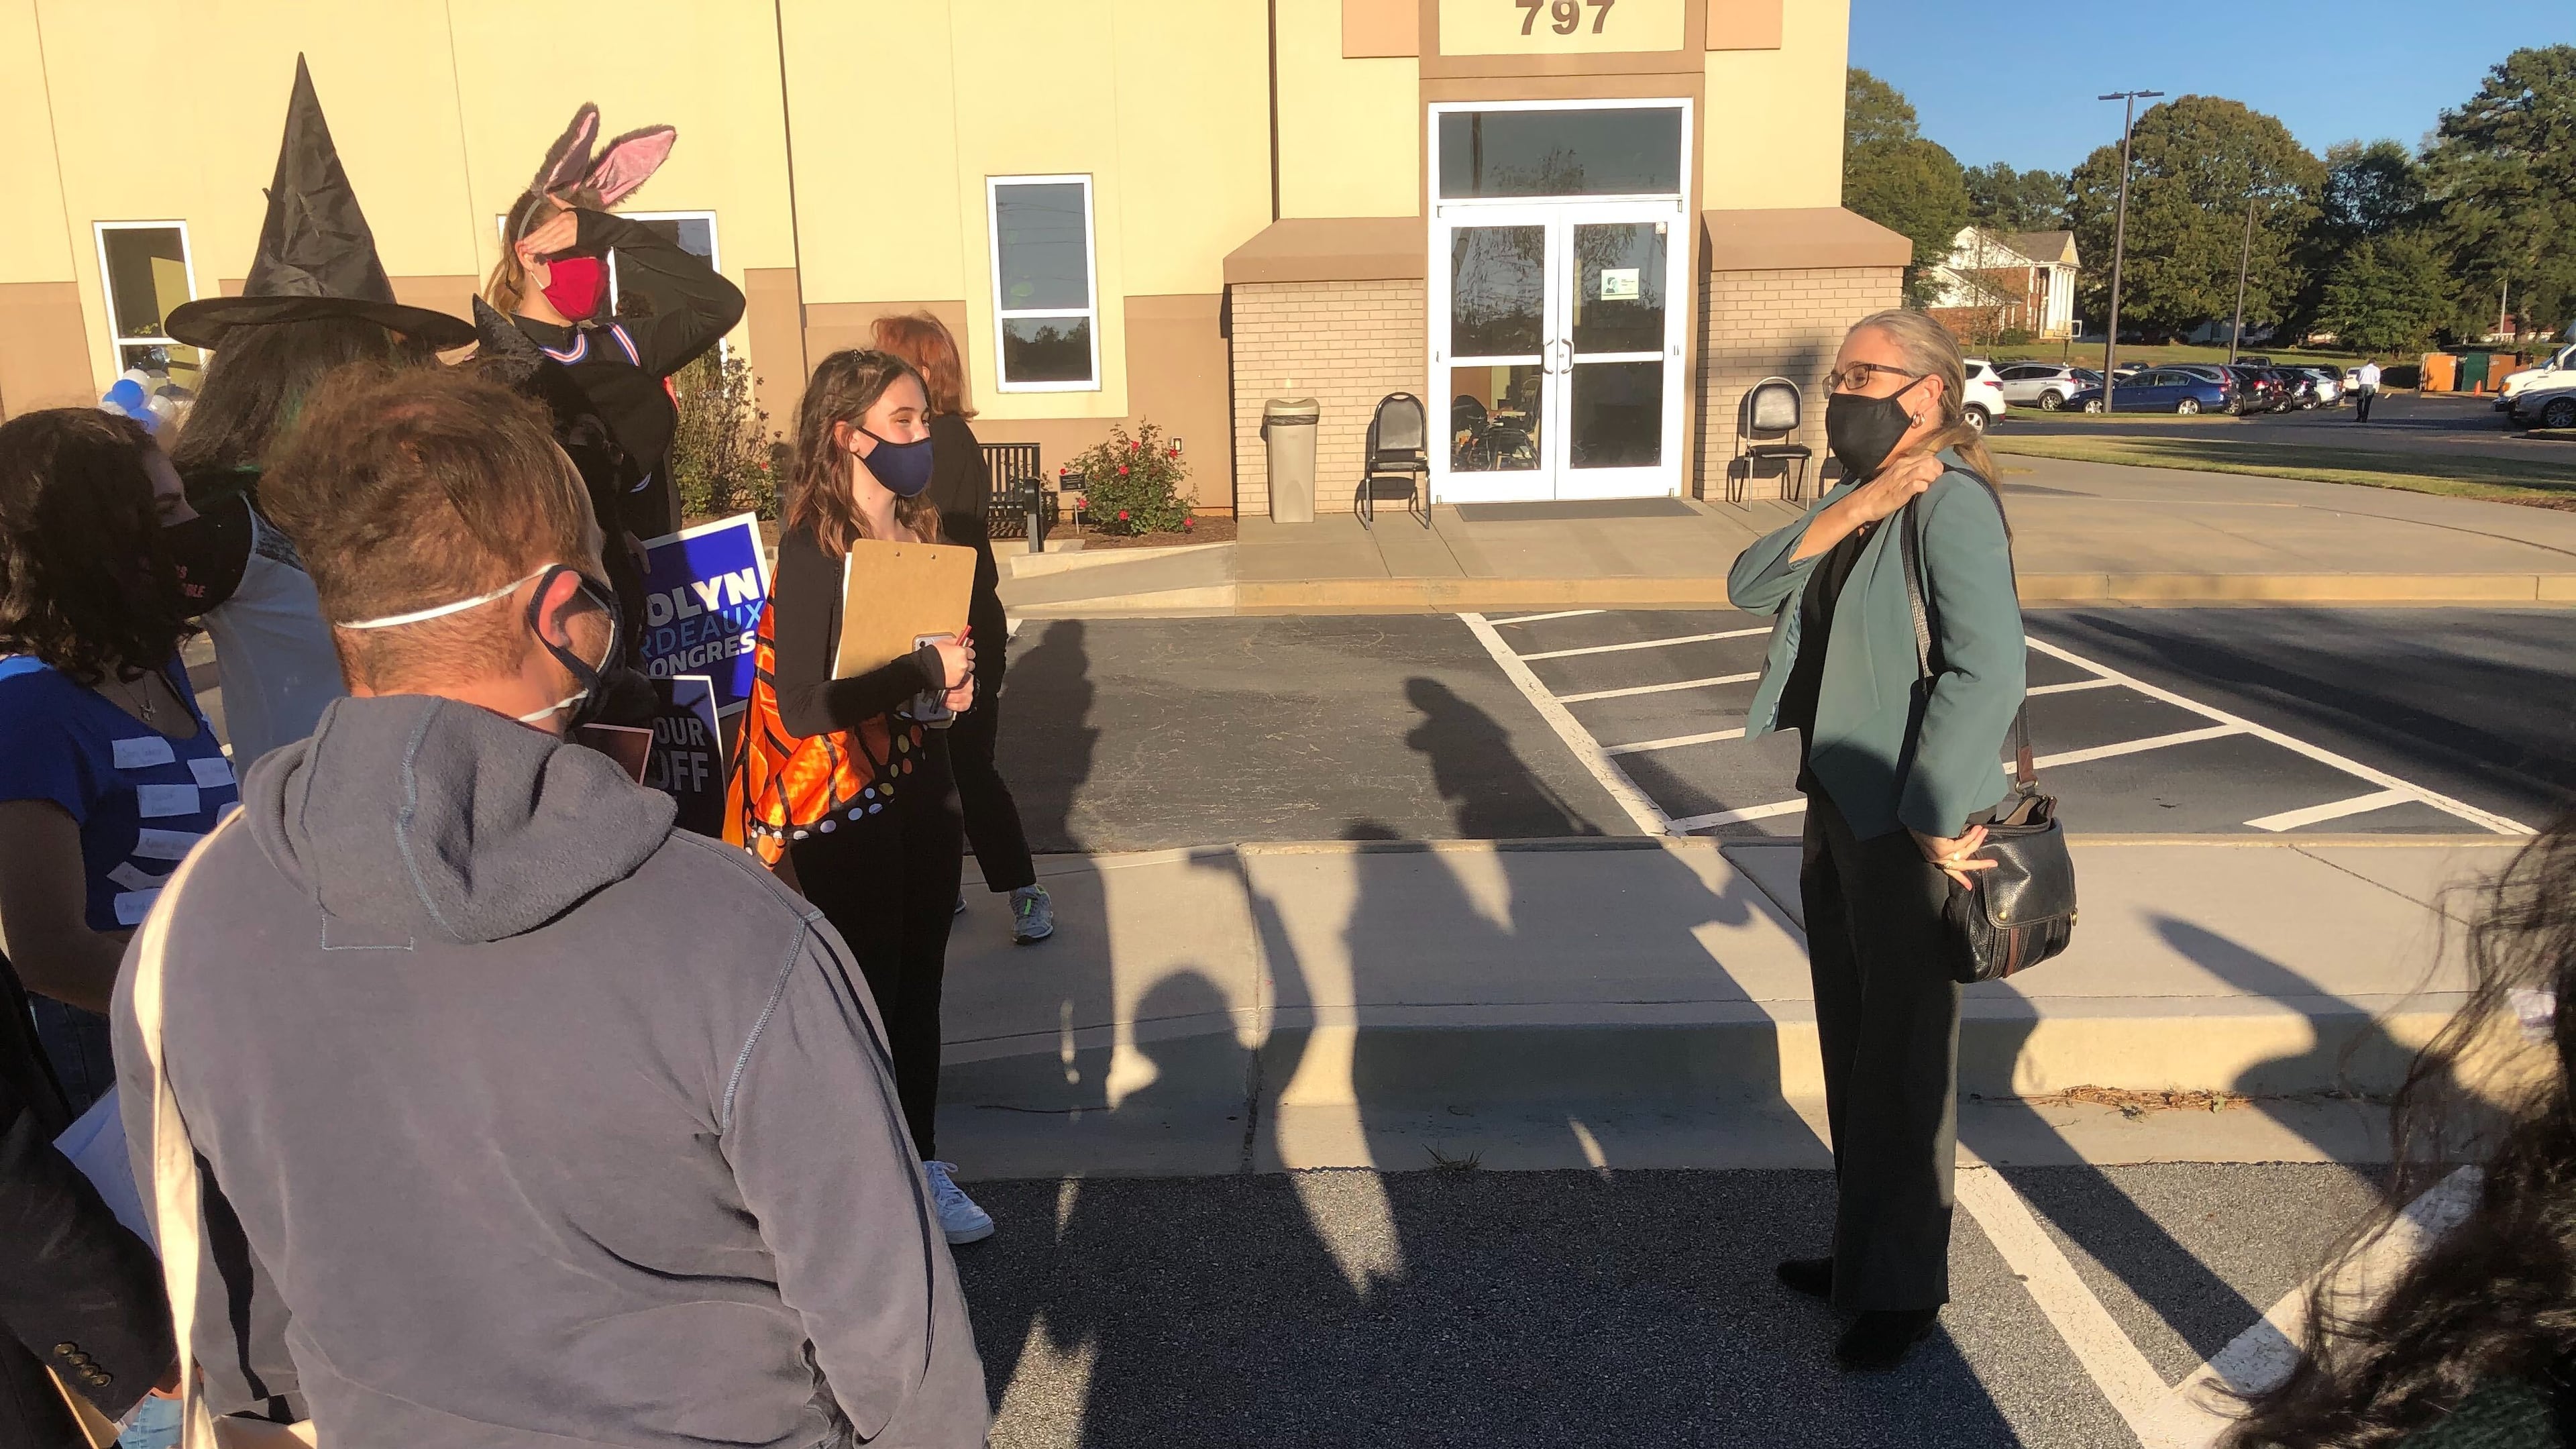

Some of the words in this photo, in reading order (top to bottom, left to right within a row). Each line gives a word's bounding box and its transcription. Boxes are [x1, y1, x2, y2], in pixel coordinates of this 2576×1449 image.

[1515, 0, 1615, 35] 797
[647, 566, 761, 627] OLYN
[646, 630, 757, 677] ONGRES
[653, 716, 705, 747] OUR
